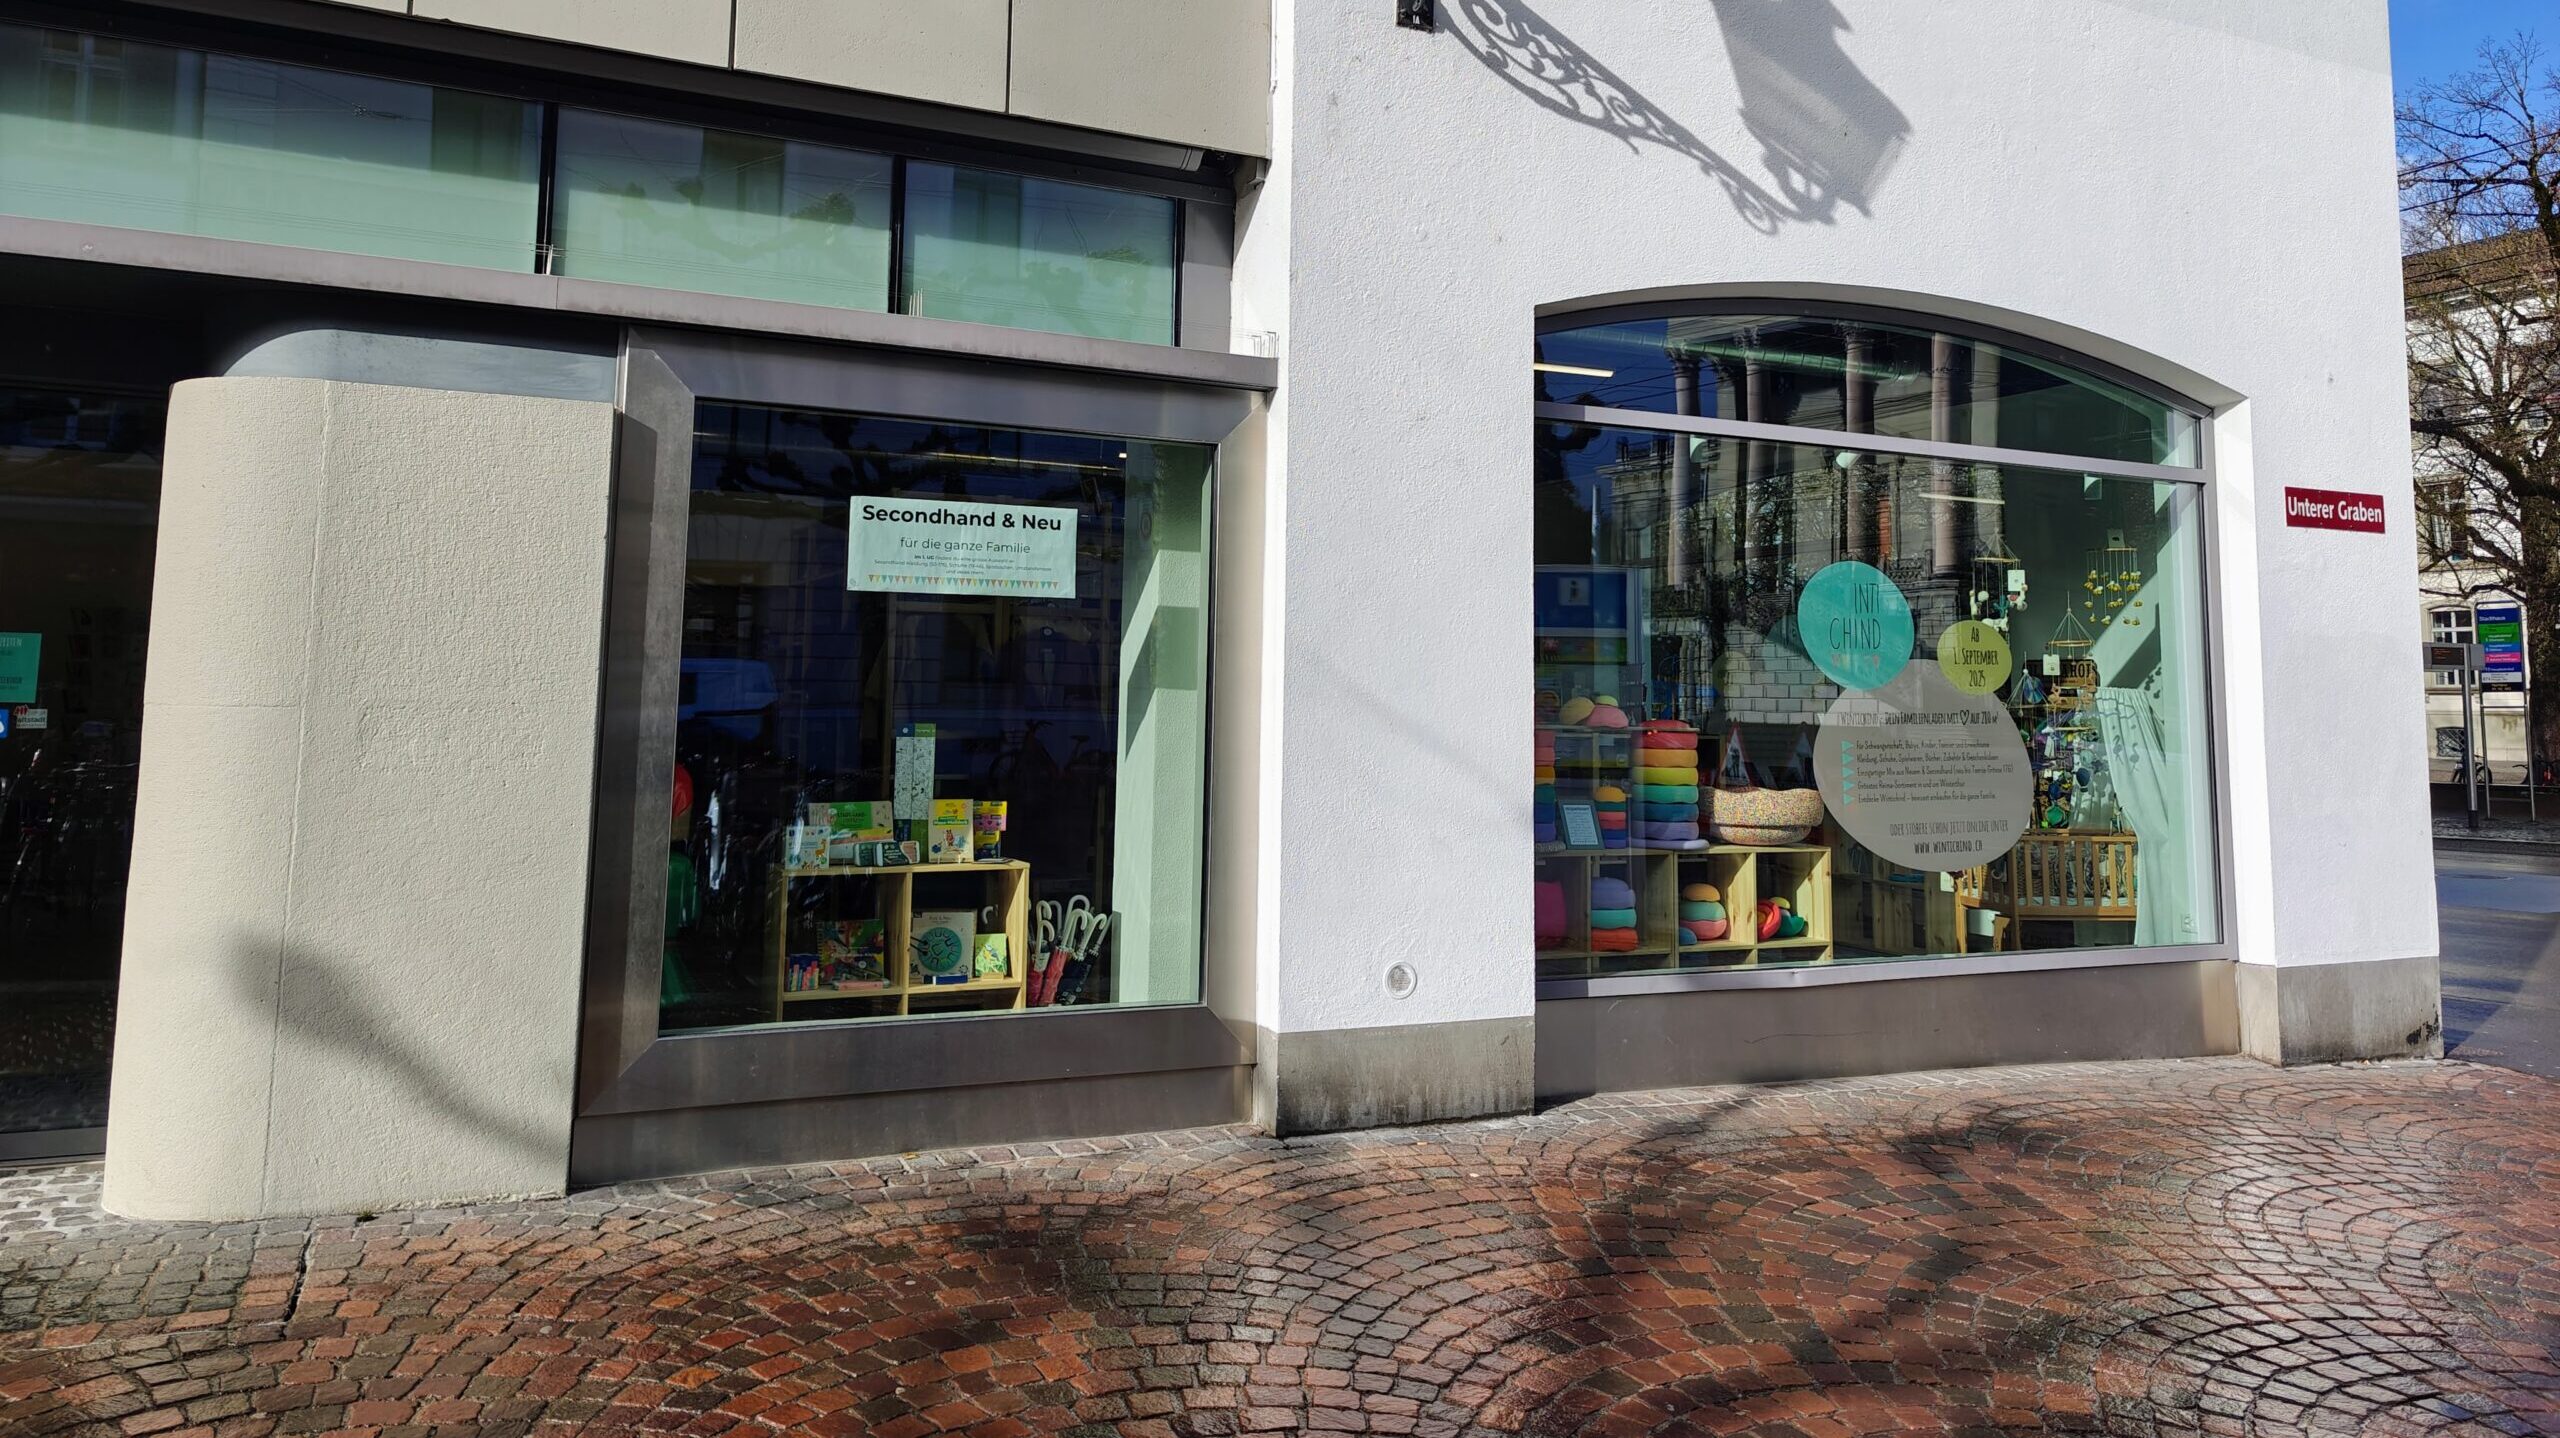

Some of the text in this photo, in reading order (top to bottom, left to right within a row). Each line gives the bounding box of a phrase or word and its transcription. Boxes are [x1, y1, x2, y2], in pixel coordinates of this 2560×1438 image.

[862, 504, 1061, 531] Secondhand & Neu
[2287, 496, 2383, 523] Unterer Graben
[900, 537, 1031, 553] für die ganze Familie
[1829, 617, 1881, 650] CHIND
[1970, 626, 1980, 643] AB
[1961, 648, 1999, 666] SEPTEMBER
[1969, 669, 1986, 687] 2025
[1889, 823, 1904, 837] ODER
[1966, 820, 1990, 833] ONLINE
[1990, 819, 2009, 833] UNTER
